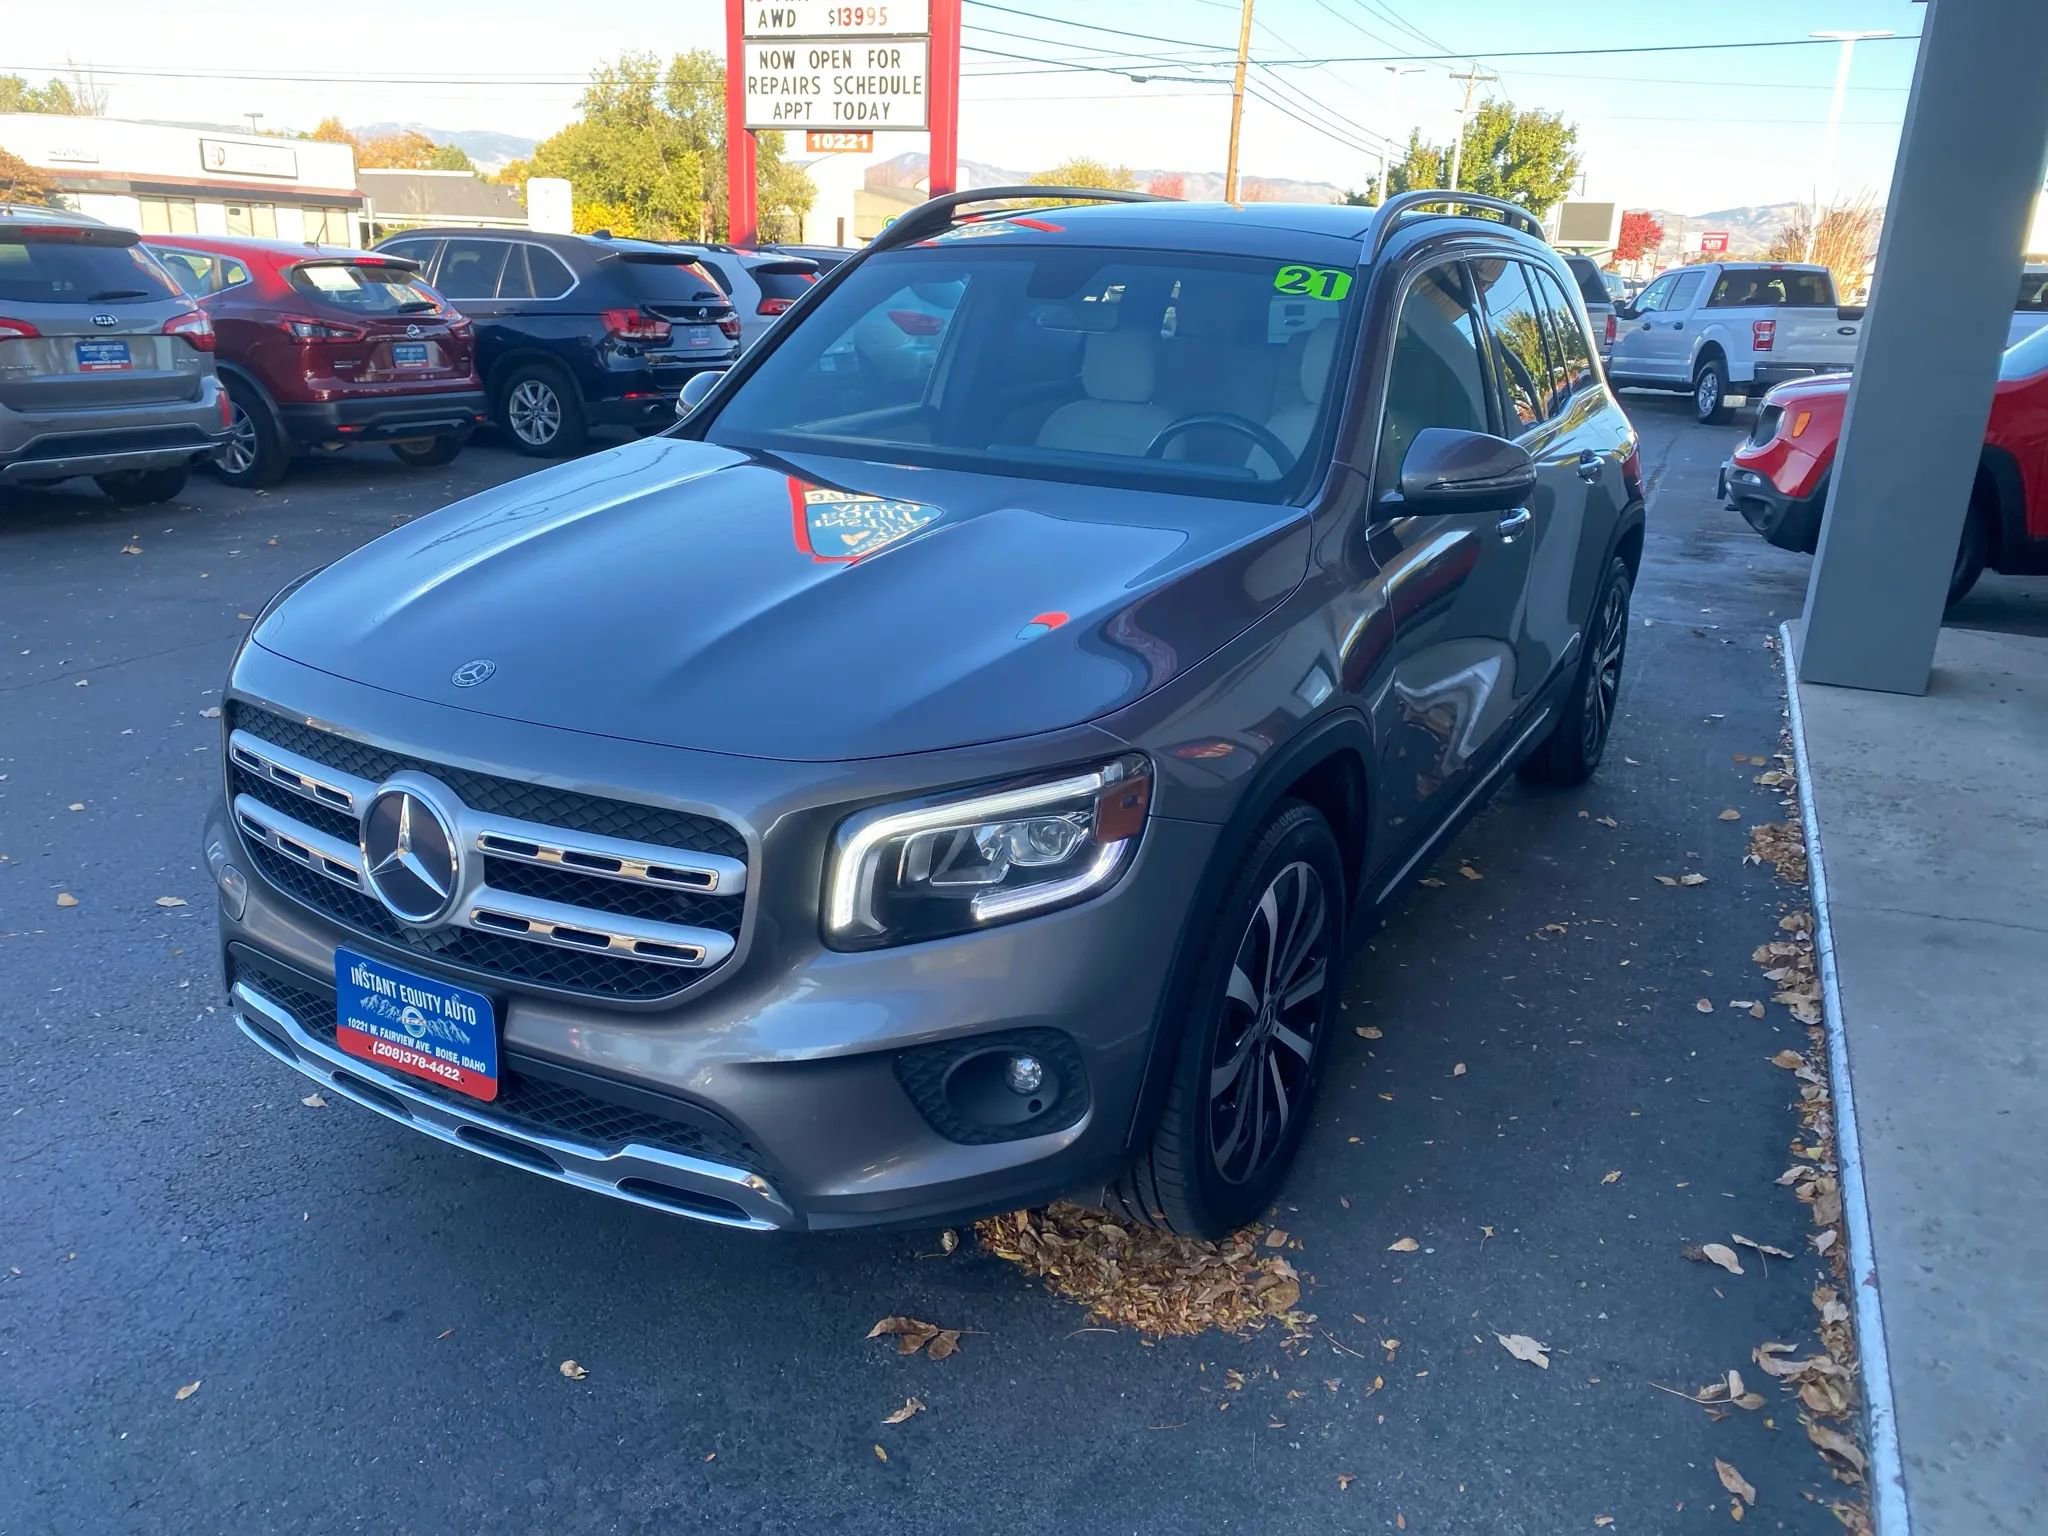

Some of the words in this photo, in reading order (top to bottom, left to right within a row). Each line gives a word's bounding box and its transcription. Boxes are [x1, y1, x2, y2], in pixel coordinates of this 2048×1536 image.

[758, 8, 797, 28] AWD
[828, 7, 888, 27] $13995
[759, 50, 796, 70] NOW
[809, 49, 852, 69] OPEN
[867, 49, 901, 69] FOR
[748, 76, 821, 95] REPAIRS
[833, 75, 922, 95] SCHEDULE
[773, 102, 813, 120] APPT
[833, 101, 891, 121] TODAY
[811, 133, 869, 150] 10221
[1279, 268, 1339, 298] 21
[351, 966, 397, 998] INSTANT
[399, 984, 441, 1014] EQUITY
[445, 999, 476, 1026] AUTO
[347, 1016, 368, 1033] 10221
[370, 1023, 379, 1036] W.
[380, 1027, 415, 1047] FAIRVIEW
[415, 1040, 432, 1054] AVE.
[435, 1046, 460, 1066] BOISE,
[461, 1055, 486, 1073] IDAHO
[372, 1040, 460, 1082] (208)378-4422
